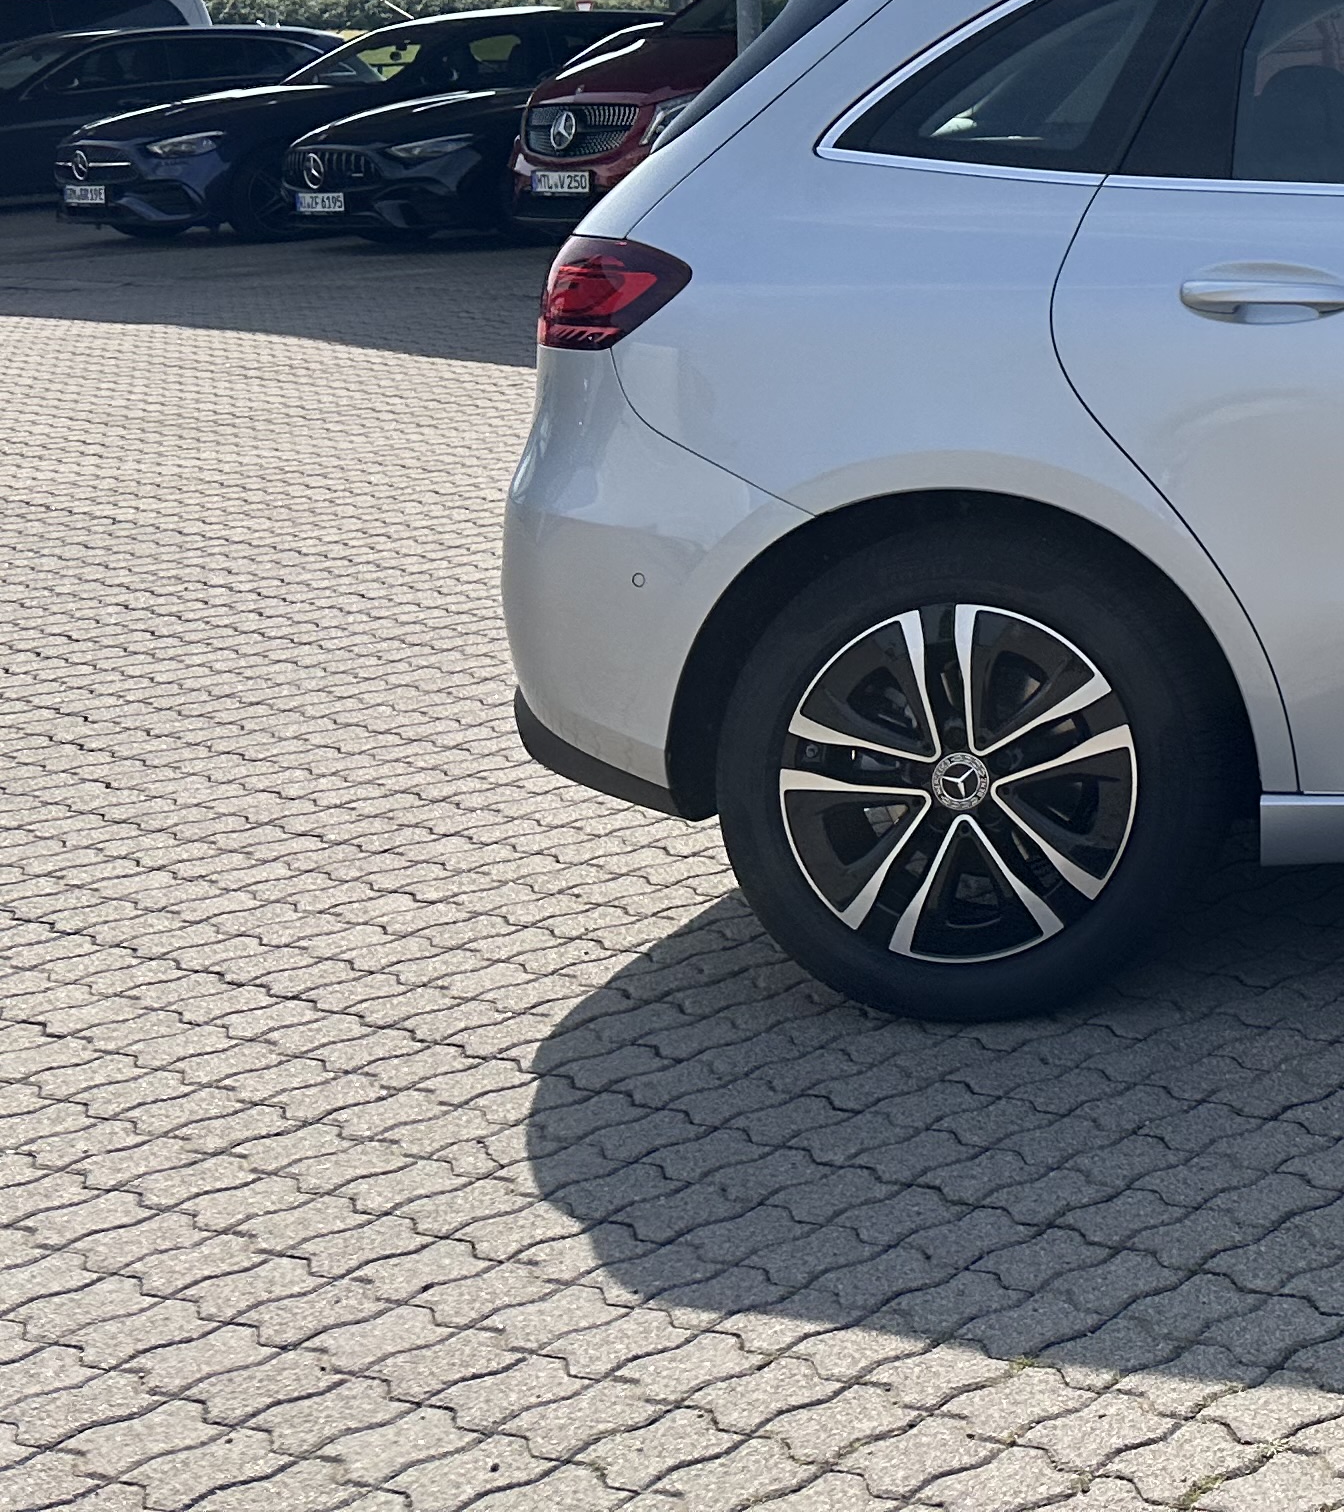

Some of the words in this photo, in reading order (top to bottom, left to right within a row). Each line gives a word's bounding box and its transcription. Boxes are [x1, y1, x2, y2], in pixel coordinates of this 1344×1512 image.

[558, 174, 566, 190] V
[566, 174, 587, 190] 250
[321, 195, 343, 209] 6195
